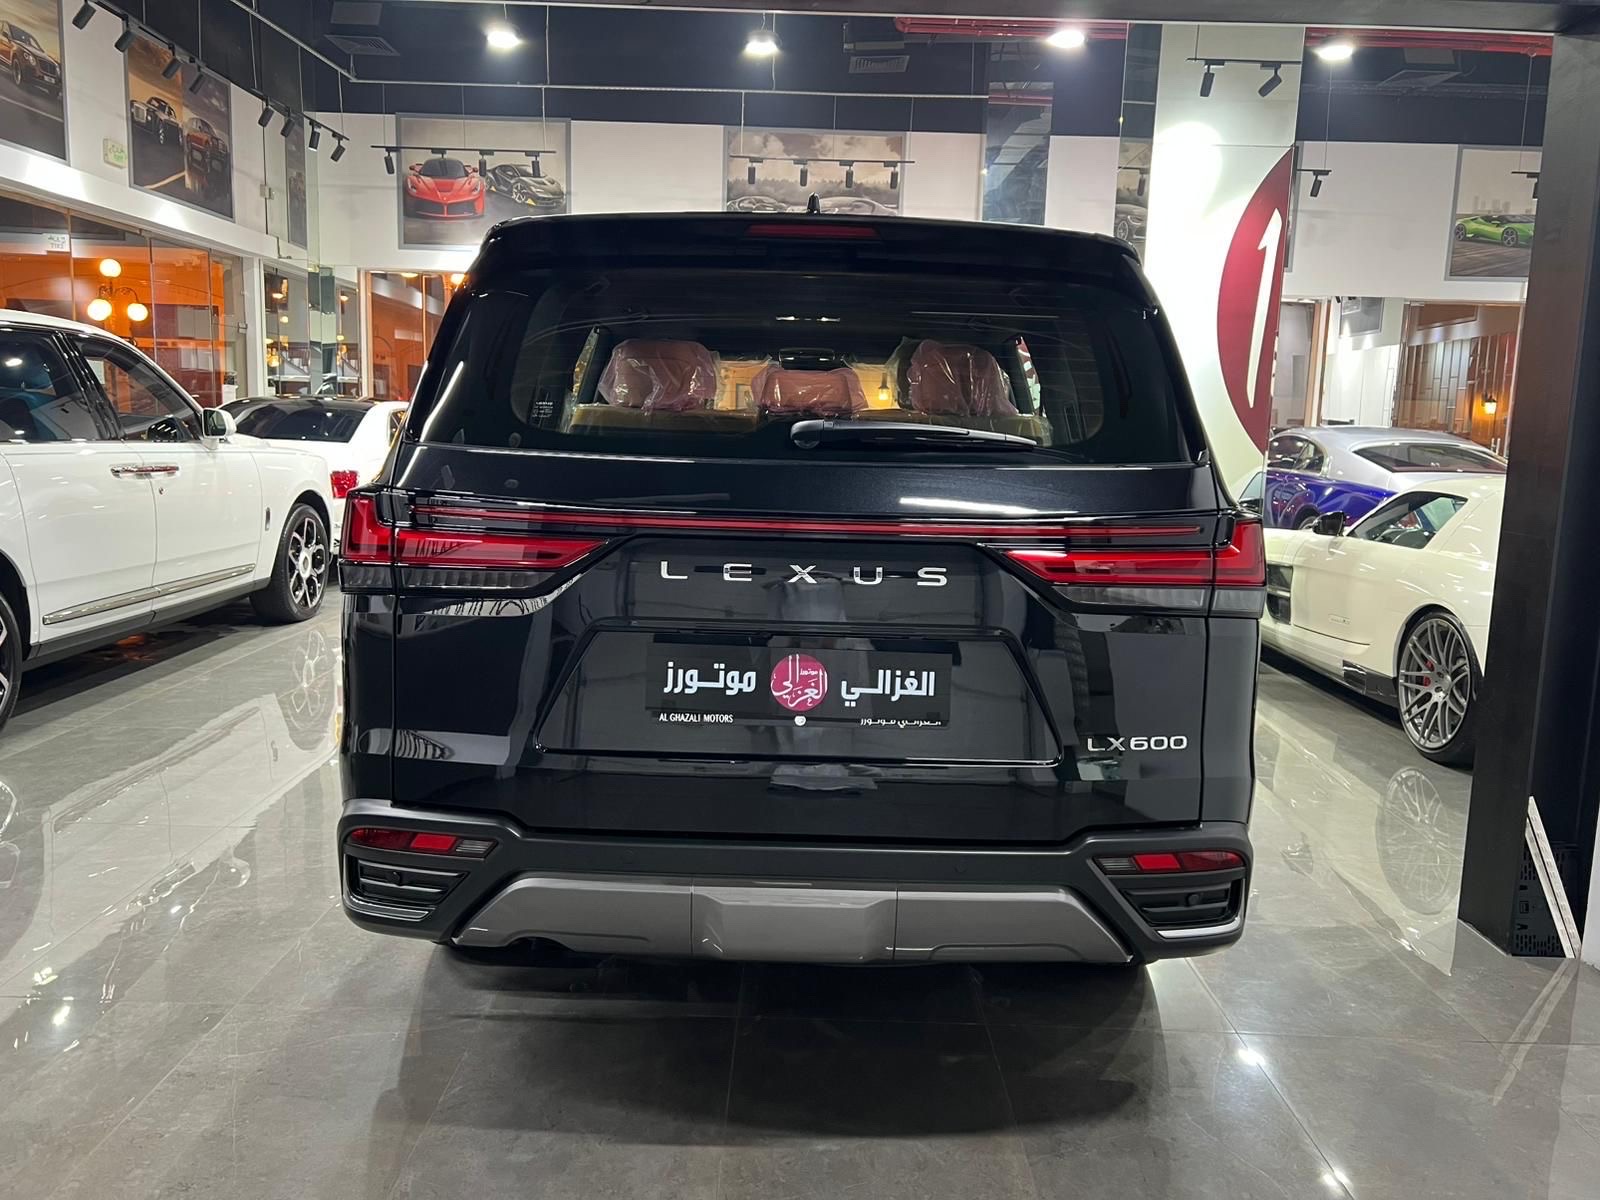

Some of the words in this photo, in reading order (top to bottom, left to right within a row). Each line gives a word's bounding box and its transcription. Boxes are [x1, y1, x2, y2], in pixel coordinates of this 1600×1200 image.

[660, 560, 948, 587] LEXUS
[663, 661, 757, 696] موتورز
[840, 669, 936, 708] الغزالي
[658, 713, 669, 722] AL
[669, 713, 701, 722] GHAZALI
[703, 714, 734, 723] MOTORS
